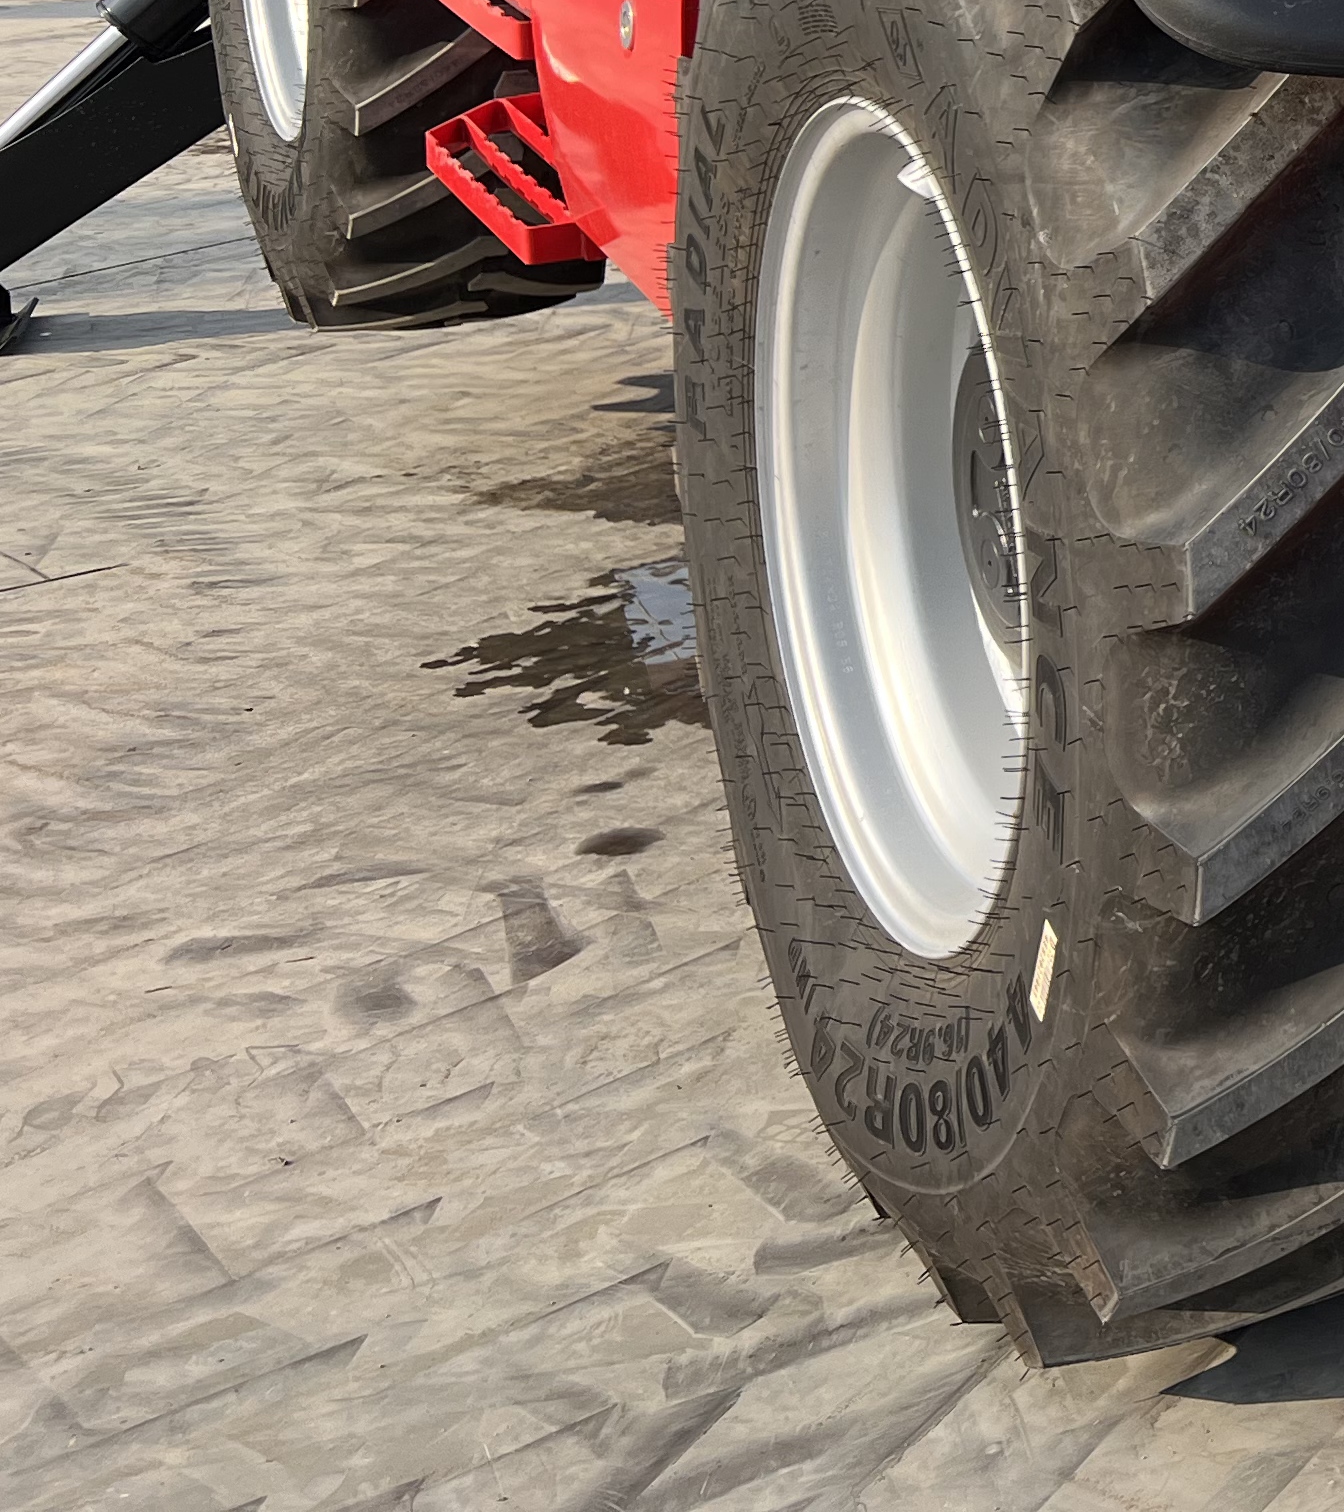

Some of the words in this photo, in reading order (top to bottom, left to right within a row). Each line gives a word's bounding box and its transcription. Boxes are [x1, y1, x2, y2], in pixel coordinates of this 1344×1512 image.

[683, 105, 726, 440] RADIAL
[809, 971, 1033, 1159] 440/80R24
[866, 1005, 971, 1068] (16.9R24)
